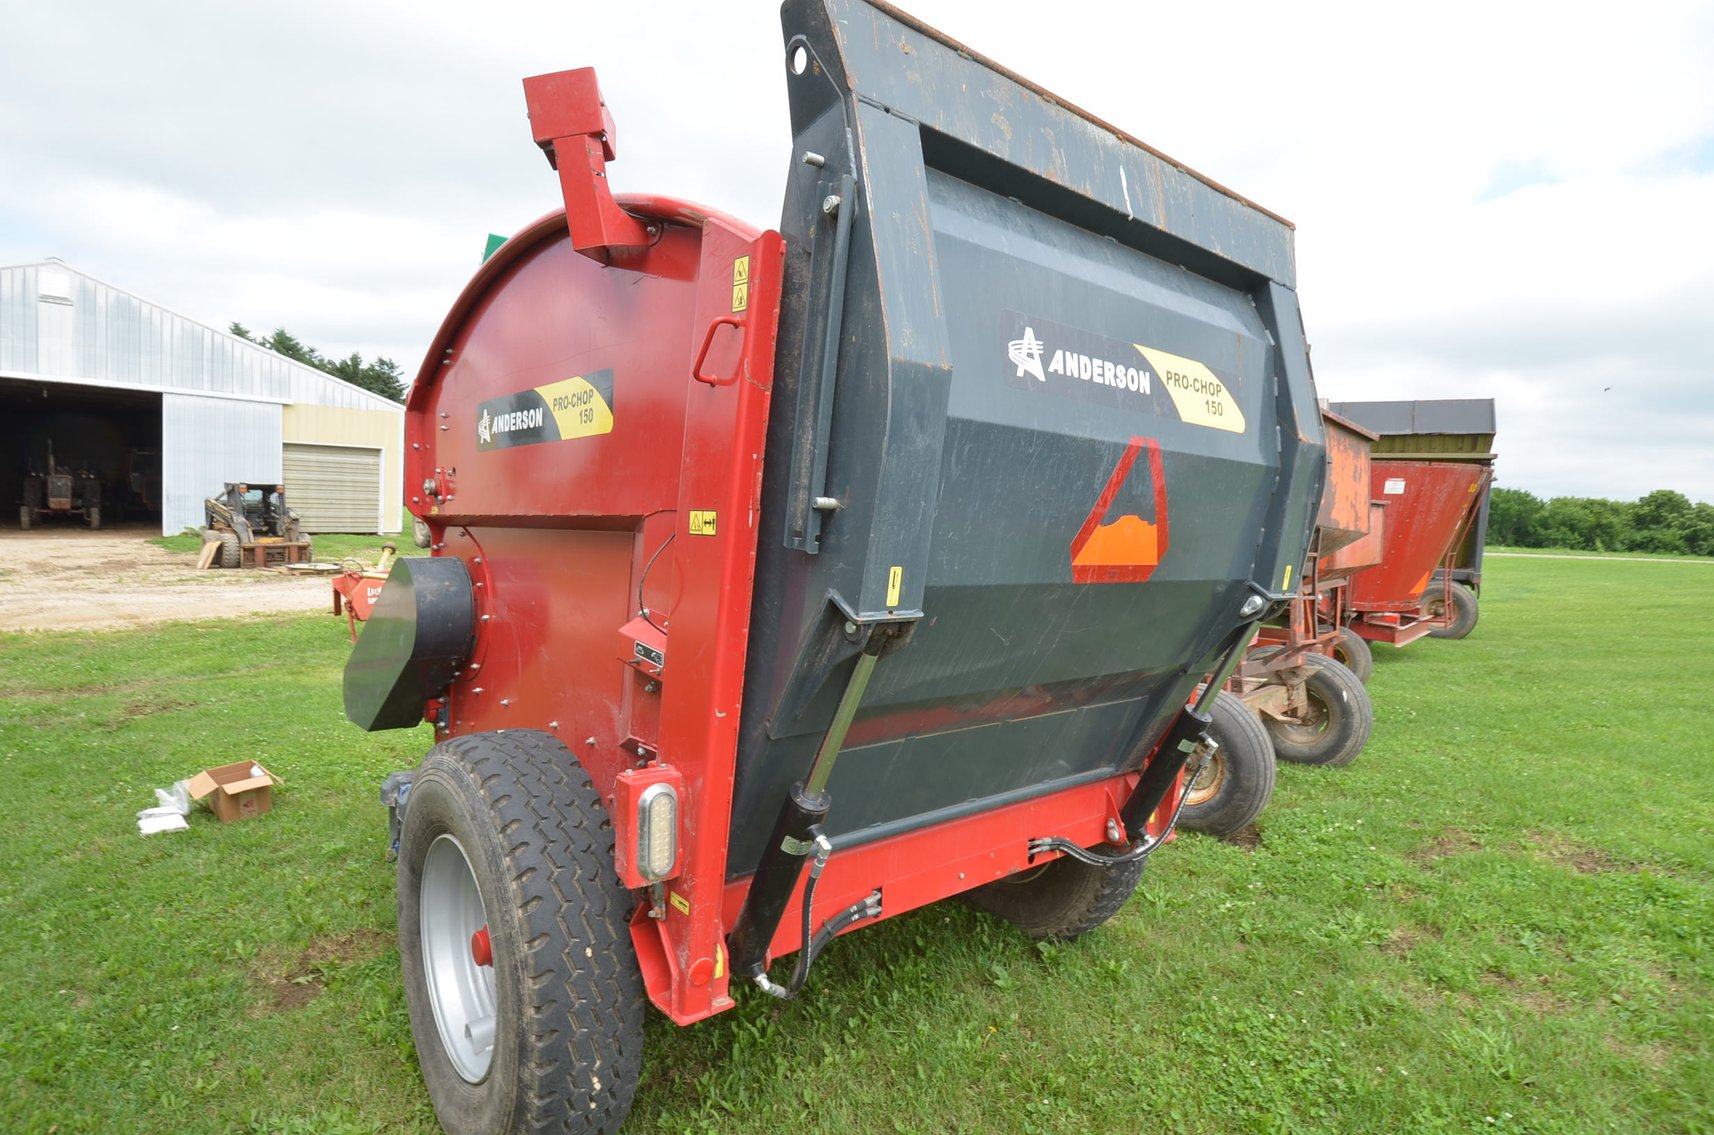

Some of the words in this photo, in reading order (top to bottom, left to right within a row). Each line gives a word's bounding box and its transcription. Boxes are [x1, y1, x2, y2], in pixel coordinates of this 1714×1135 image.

[1048, 349, 1151, 395] ANDERSON
[1166, 370, 1222, 398] PRO-CHOP
[553, 388, 594, 412] PRO-CHOP
[1205, 400, 1223, 417] 150
[491, 407, 543, 434] ANDERSON
[579, 408, 594, 424] 150
